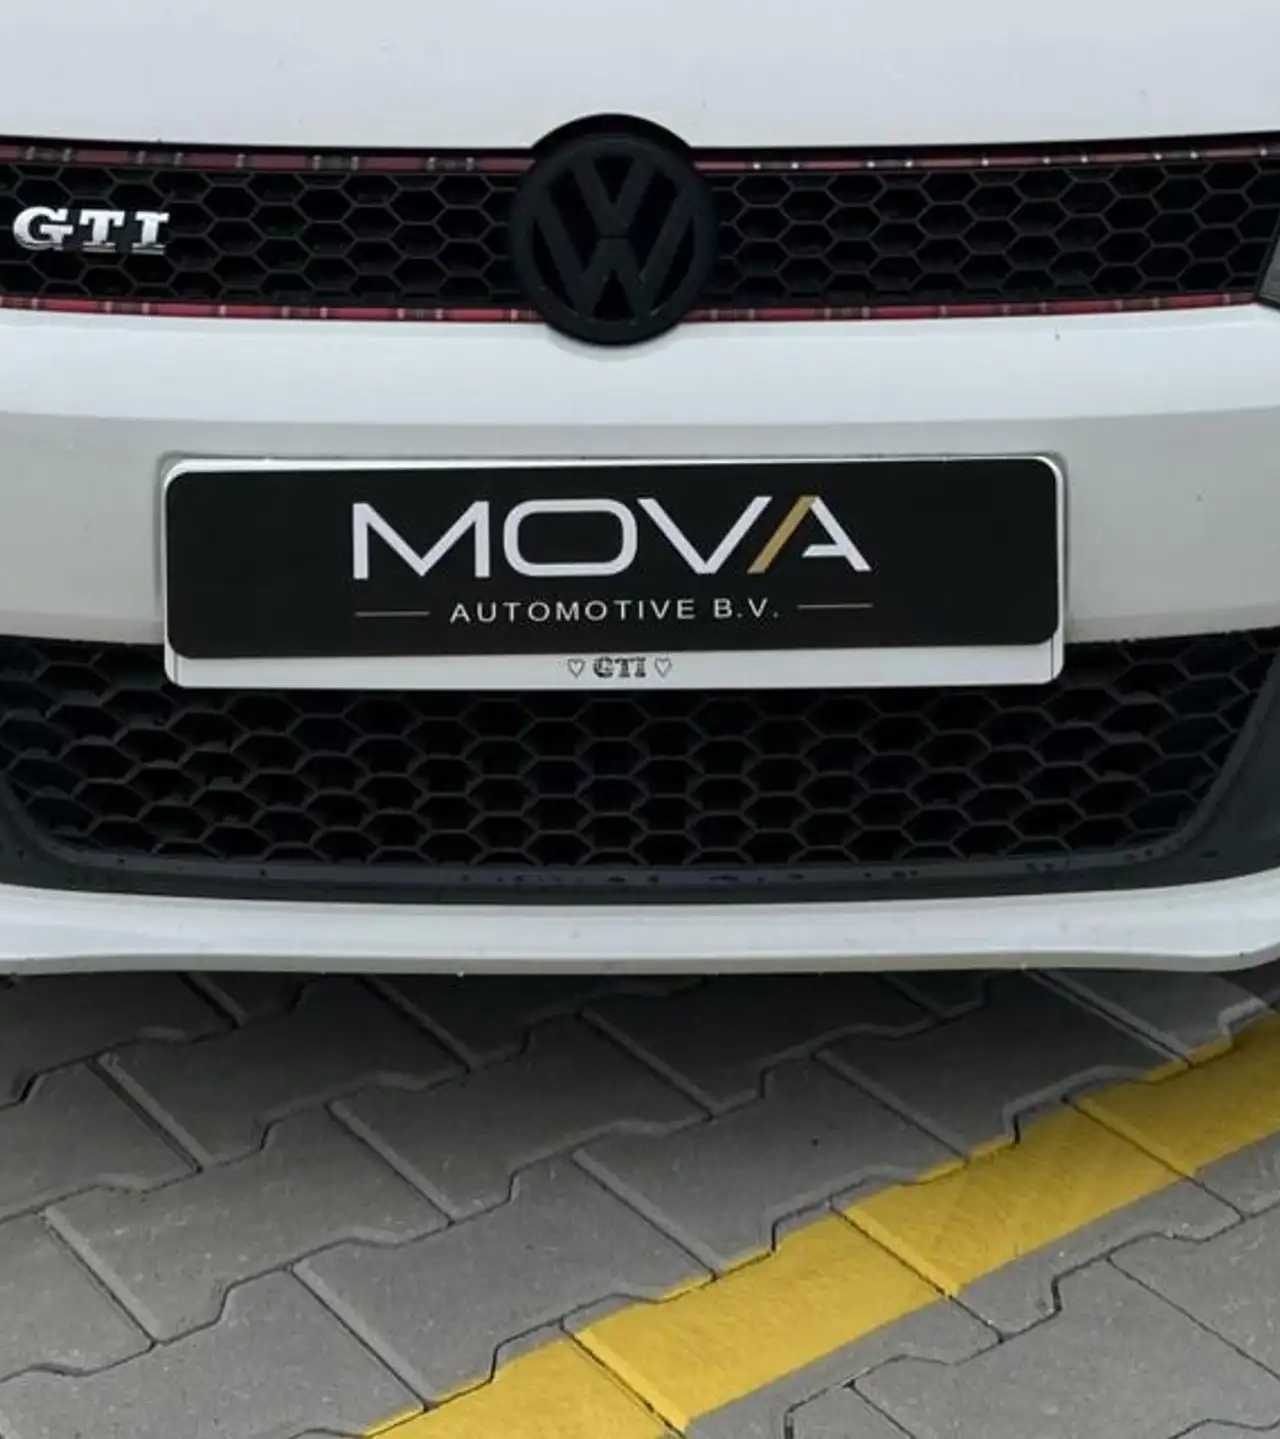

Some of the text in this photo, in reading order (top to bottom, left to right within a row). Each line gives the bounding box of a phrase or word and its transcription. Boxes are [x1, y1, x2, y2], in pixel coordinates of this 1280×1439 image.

[12, 206, 171, 255] GTI
[353, 496, 872, 579] MOVA
[451, 598, 780, 623] AUTOMOTIVE B.V.
